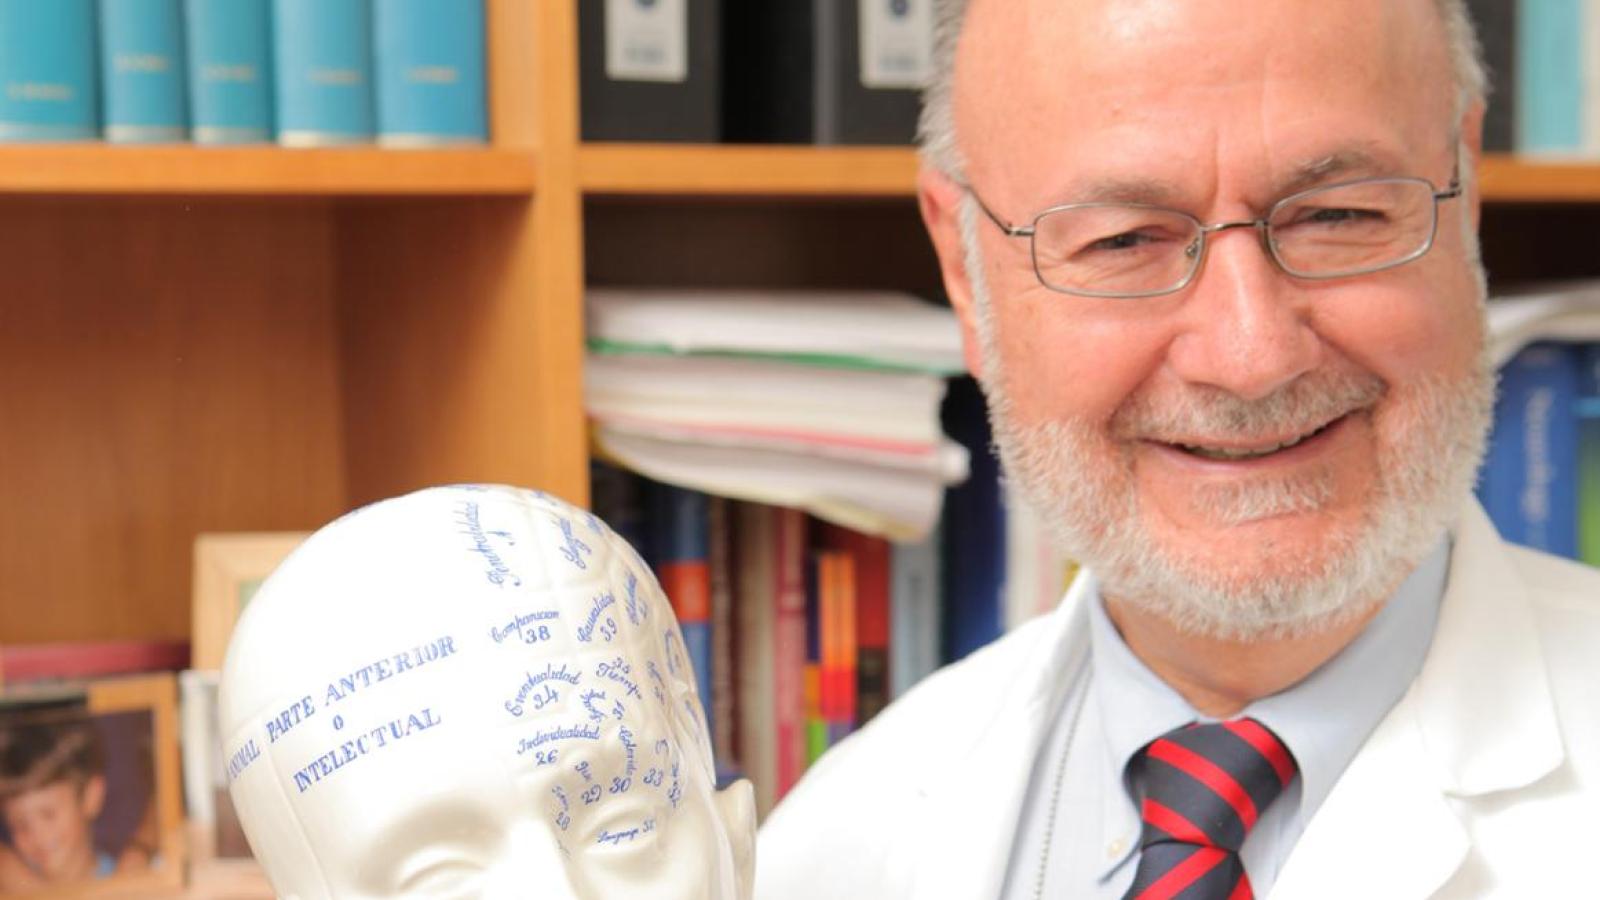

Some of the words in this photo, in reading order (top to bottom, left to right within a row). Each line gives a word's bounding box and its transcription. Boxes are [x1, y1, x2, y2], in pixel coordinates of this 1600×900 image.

[525, 625, 551, 644] 38
[266, 695, 315, 743] PARTE
[325, 635, 458, 706] ANTERIOR
[293, 708, 441, 793] INTELECTUAL
[535, 749, 559, 766] 26
[581, 784, 602, 805] 29
[609, 776, 632, 793] 30
